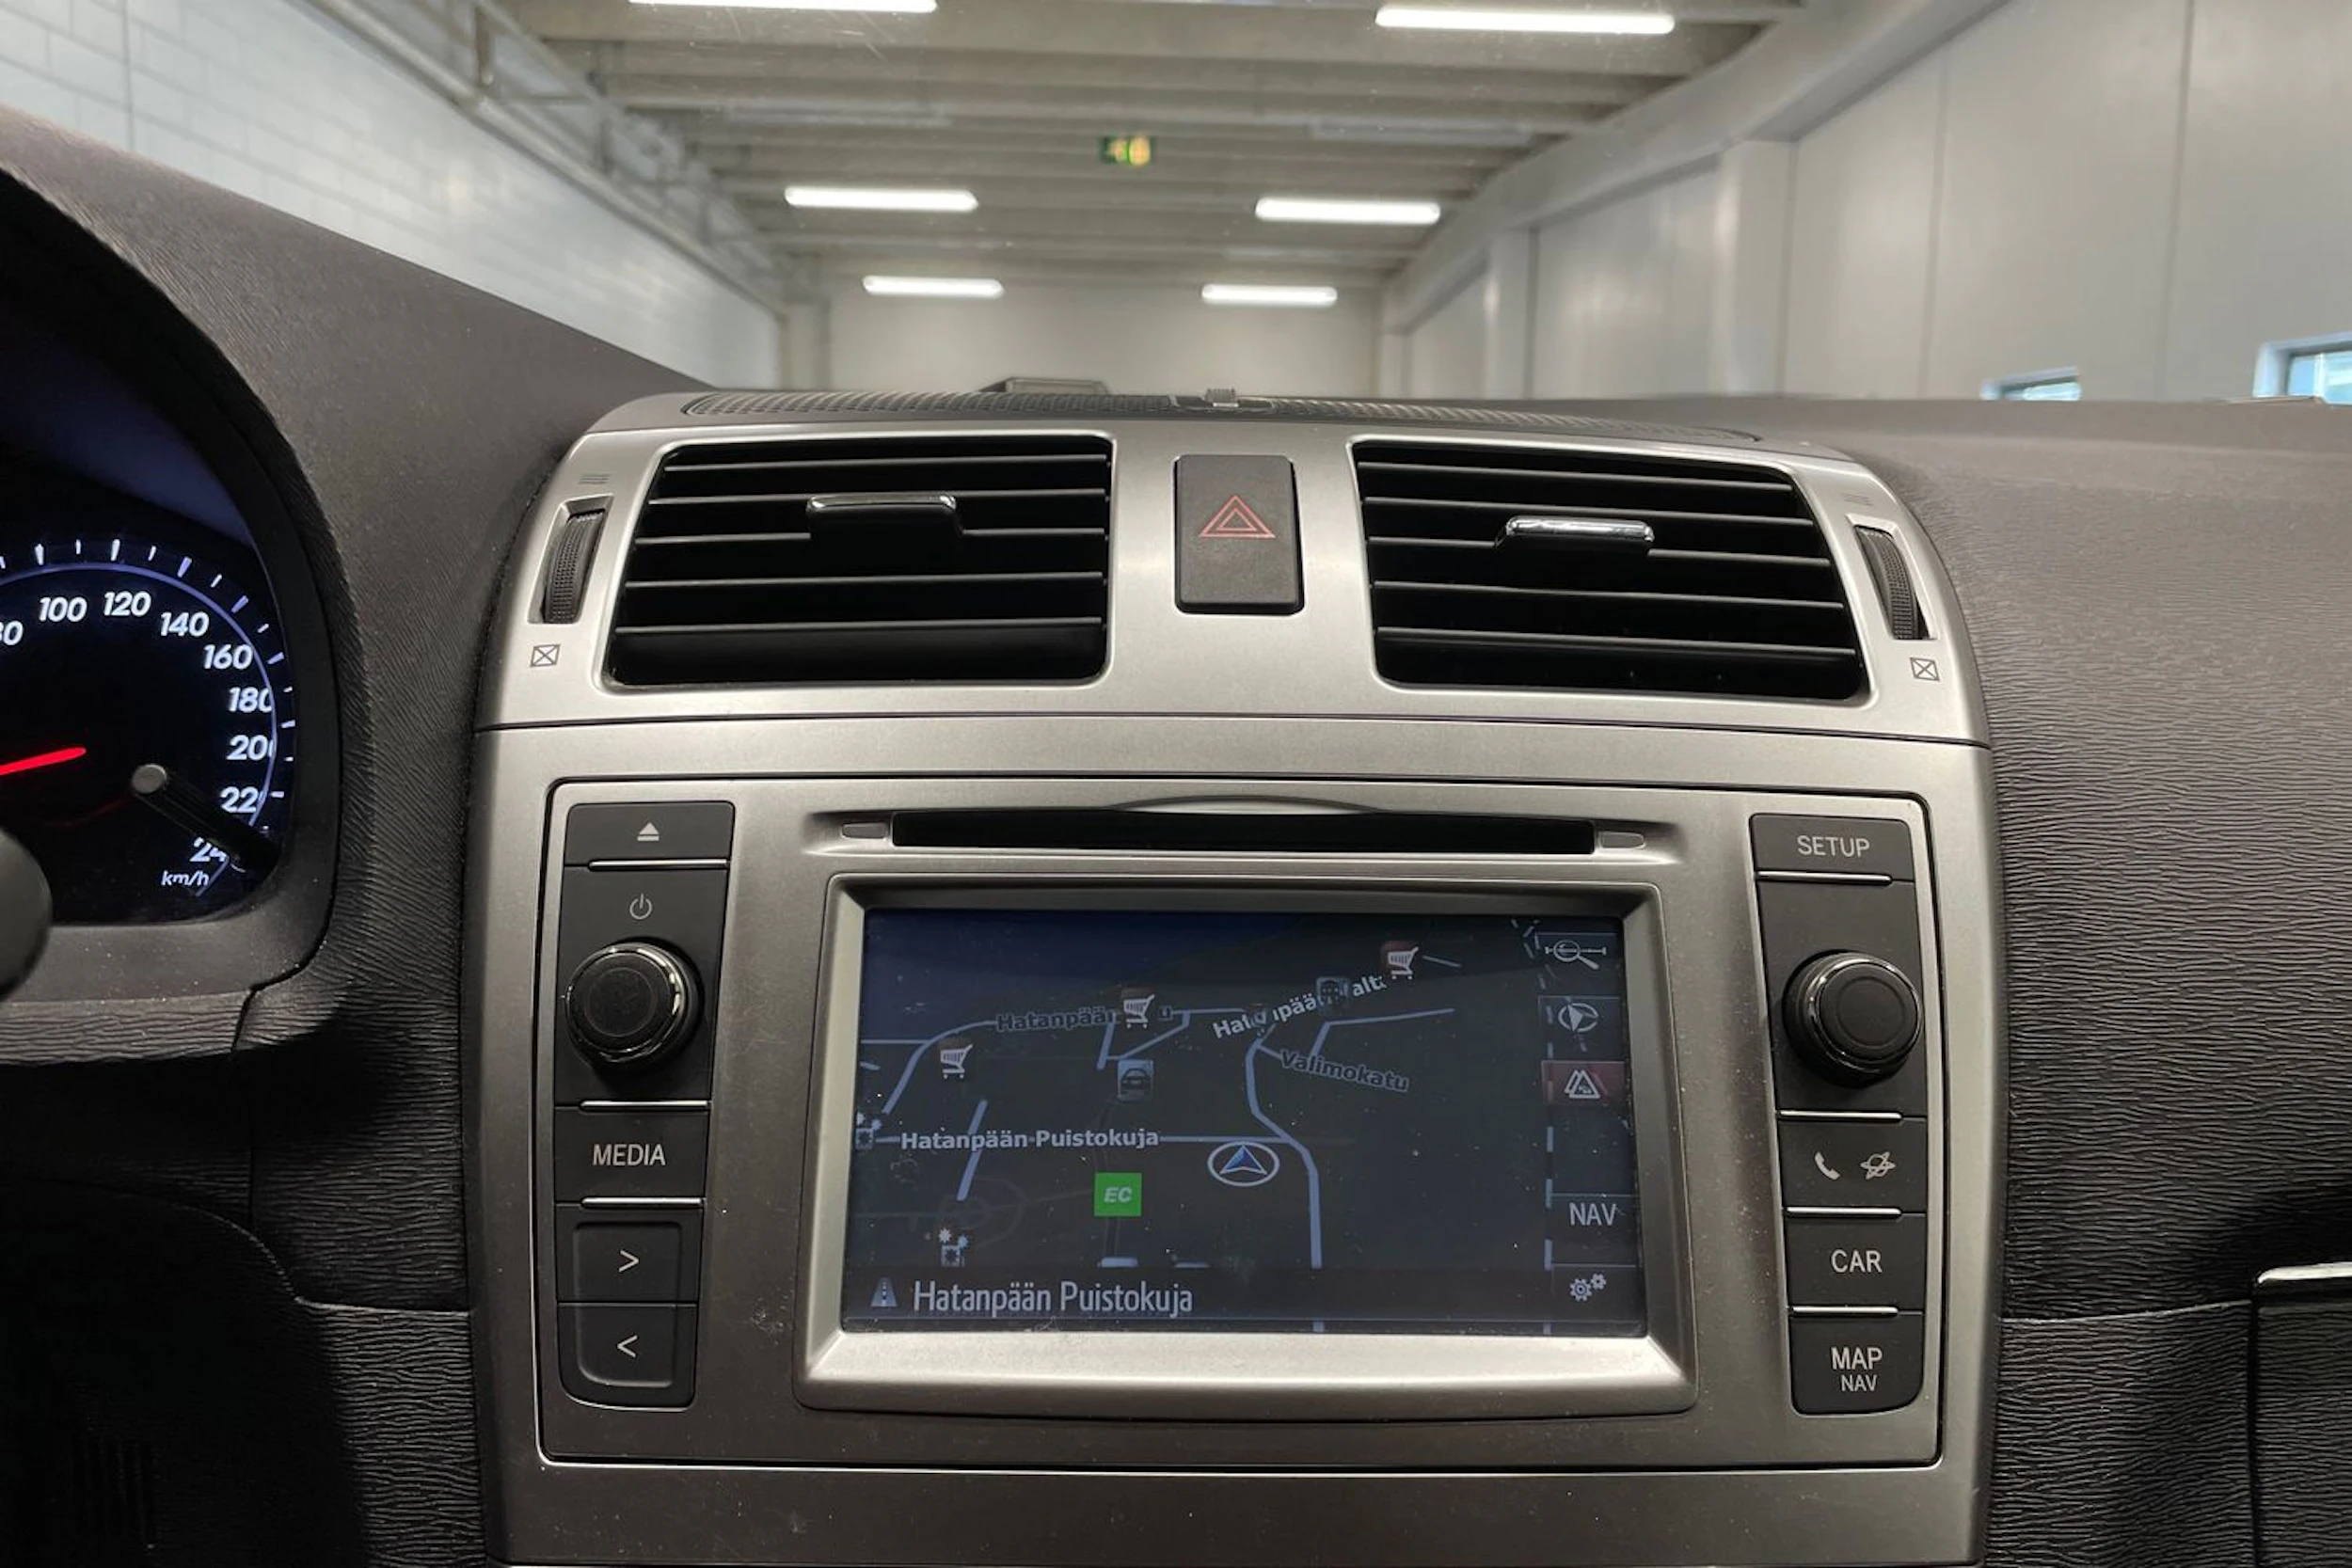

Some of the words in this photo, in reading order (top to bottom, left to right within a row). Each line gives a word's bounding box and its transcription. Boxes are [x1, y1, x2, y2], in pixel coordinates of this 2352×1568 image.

[39, 596, 87, 622] 100
[103, 591, 151, 616] 120
[161, 612, 209, 637] 140
[203, 644, 252, 670] 160
[229, 687, 272, 713] 180
[219, 786, 267, 813] 22
[1798, 835, 1870, 858] SETUP
[161, 870, 209, 886] km/h
[1279, 1049, 1409, 1092] Valimokatu
[900, 1131, 1028, 1150] Hatanpään
[1036, 1129, 1160, 1148] Puistokuja
[593, 1144, 666, 1167] MEDIA
[1103, 1186, 1133, 1203] EC
[1569, 1202, 1617, 1227] NAV
[1831, 1250, 1883, 1274] CAR
[913, 1280, 1052, 1317] Hatanpään
[1060, 1280, 1194, 1317] Puistokuja
[1831, 1346, 1883, 1370] MAP
[1841, 1373, 1878, 1393] NAV
